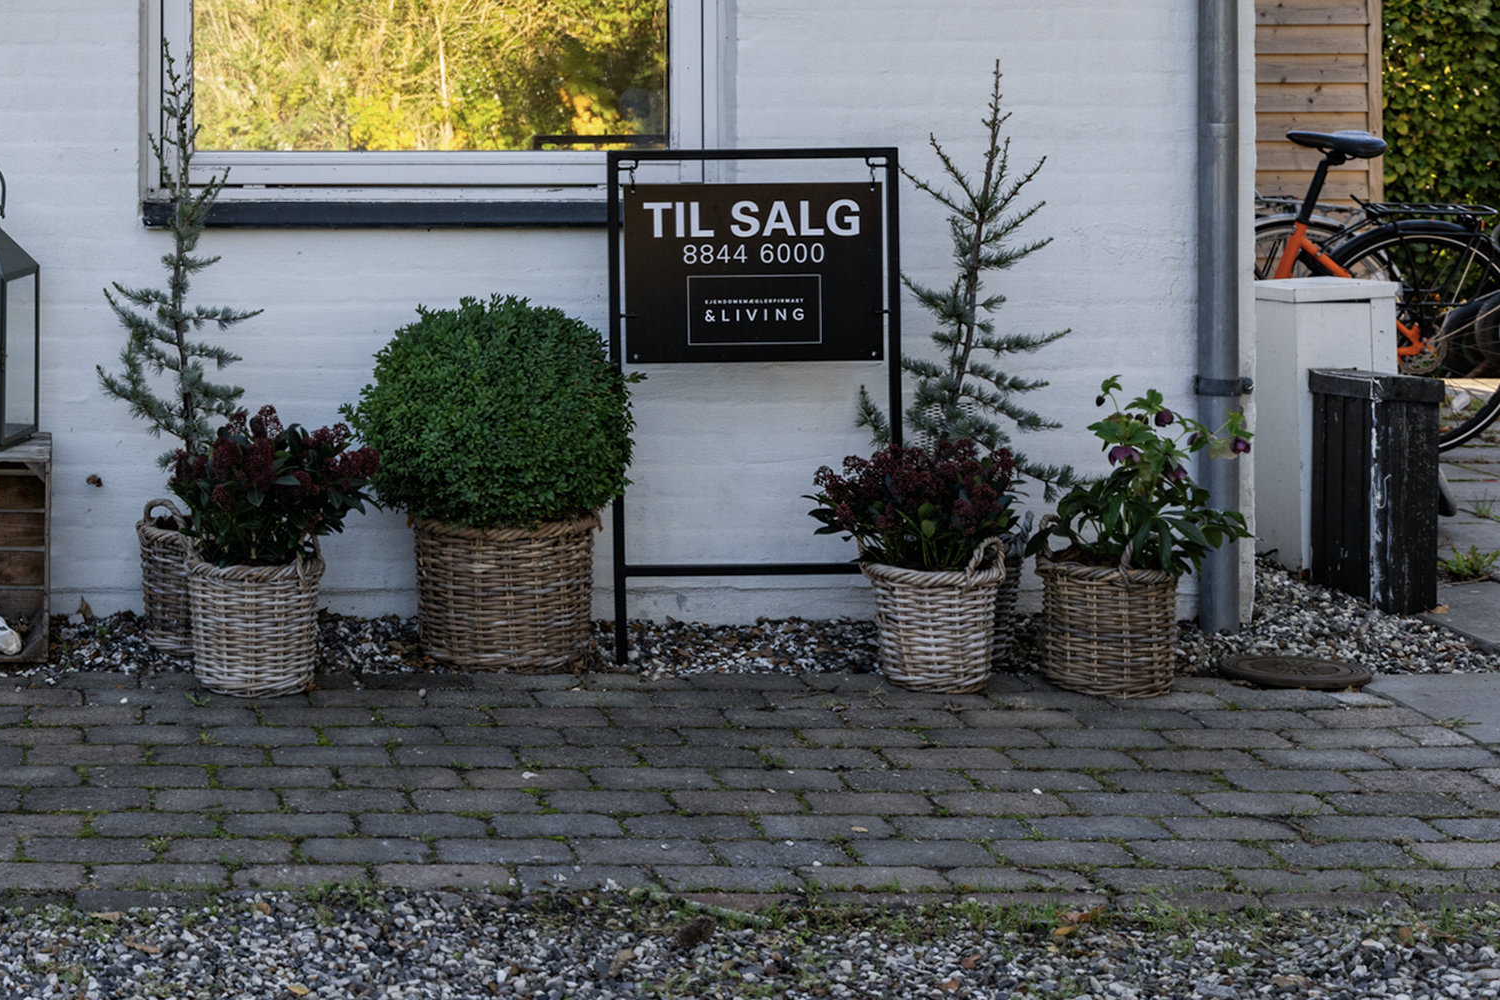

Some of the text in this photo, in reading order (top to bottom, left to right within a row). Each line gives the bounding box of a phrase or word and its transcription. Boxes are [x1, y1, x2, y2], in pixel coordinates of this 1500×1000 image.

[642, 198, 861, 238] TIL SALG
[682, 242, 825, 265] 8844 6000
